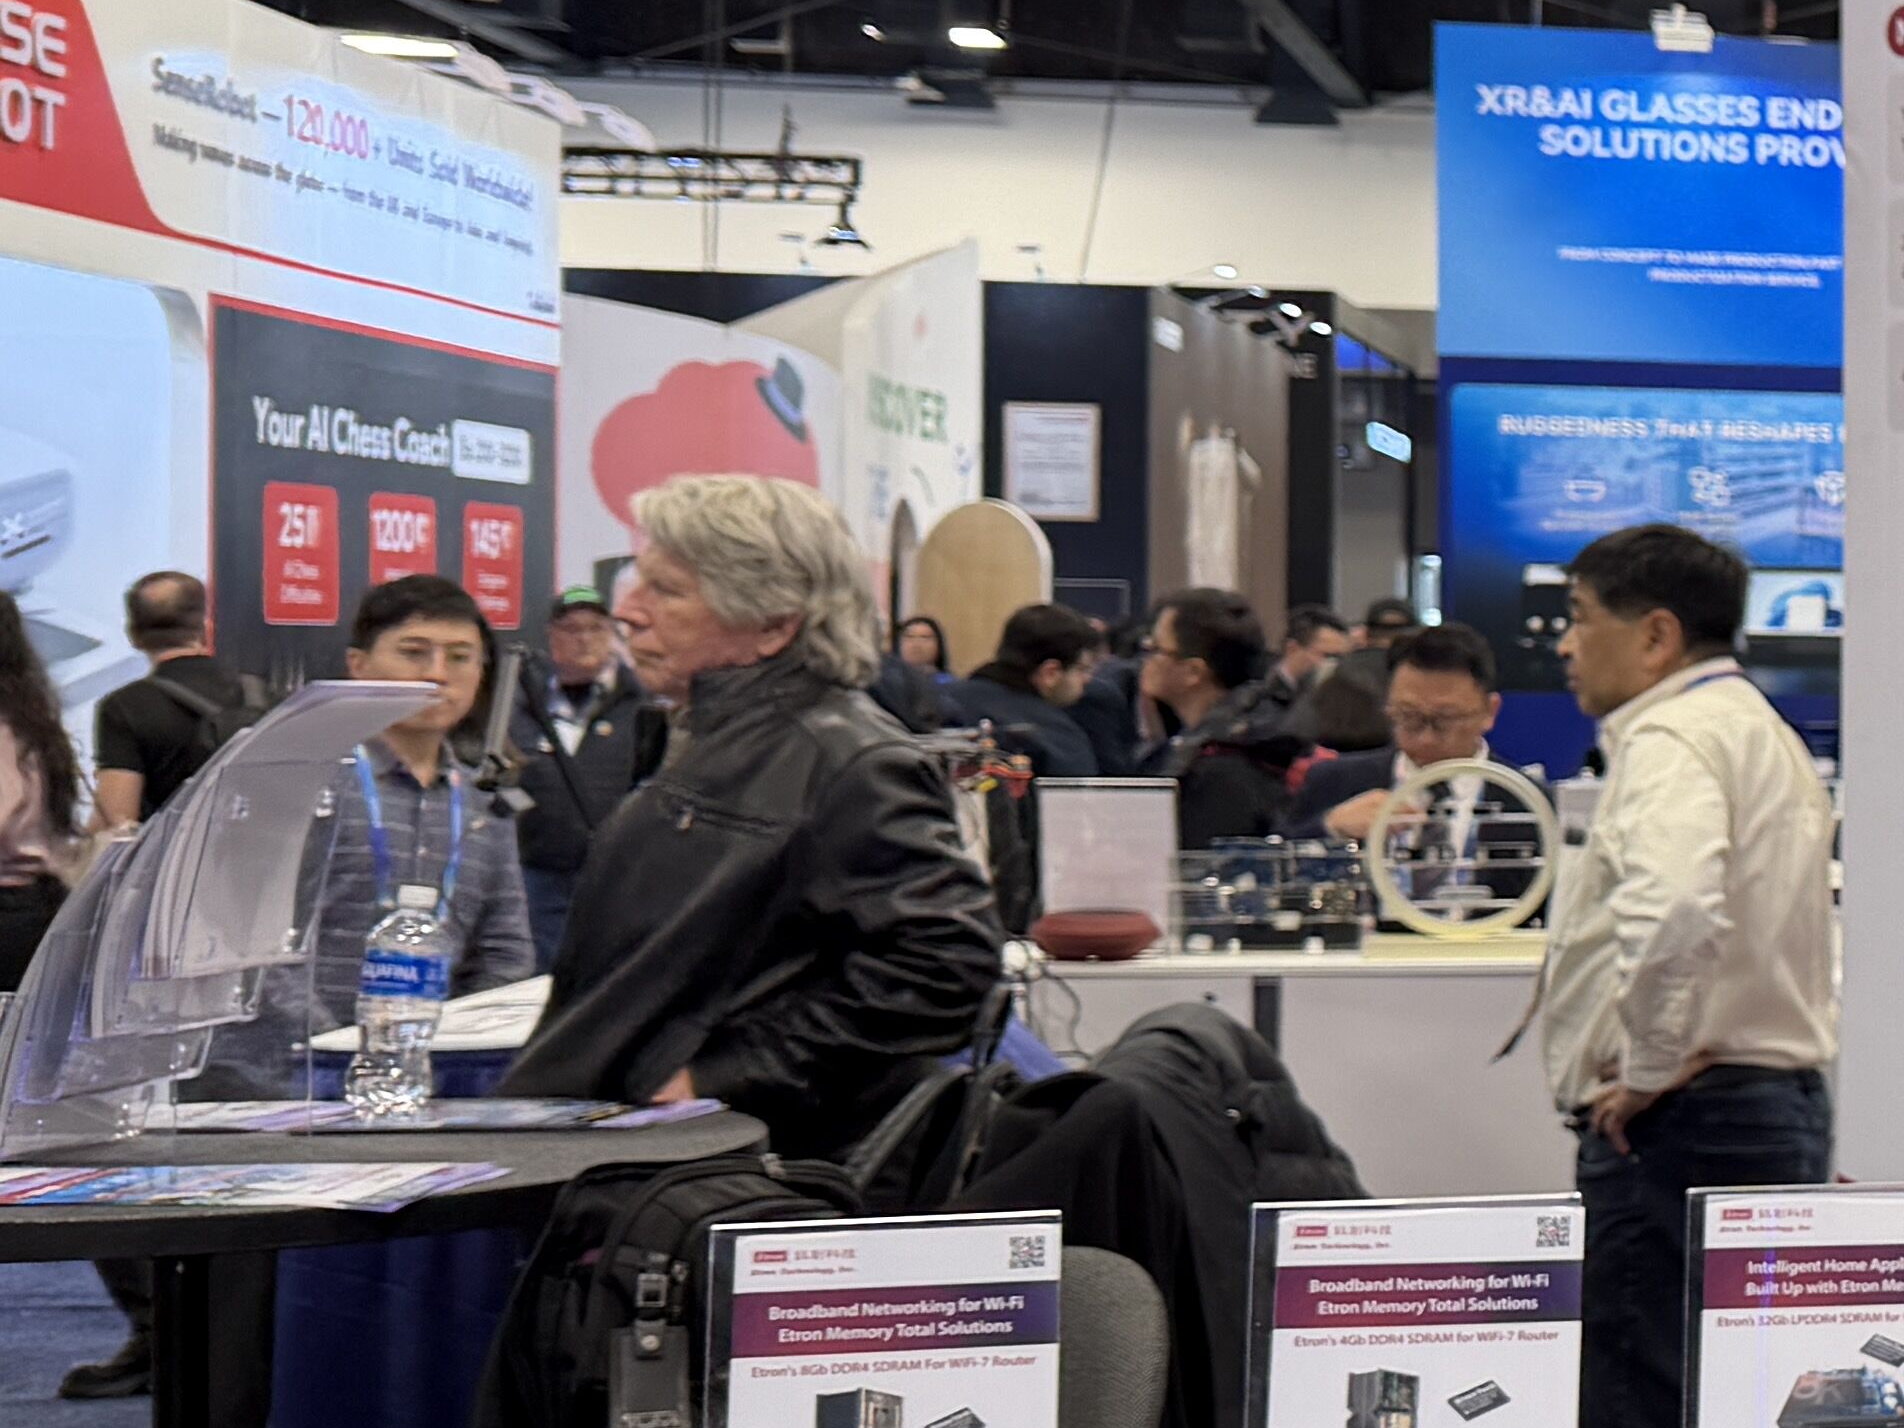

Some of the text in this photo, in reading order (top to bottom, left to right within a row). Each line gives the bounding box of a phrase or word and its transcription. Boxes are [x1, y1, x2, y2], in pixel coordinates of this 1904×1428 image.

[1475, 81, 1593, 121] XR&AI
[1600, 89, 1761, 129] GLASSES
[1538, 124, 1749, 165] SOLUTIONS
[251, 394, 306, 449] Your
[307, 403, 330, 453] AI
[333, 407, 392, 461] Chess
[393, 416, 451, 468] Coach
[1747, 1257, 1822, 1278] Intelligent
[1823, 1256, 1867, 1273] Home
[1308, 1274, 1510, 1295] Broadband Networking for
[1781, 1279, 1804, 1298] Up
[1805, 1278, 1839, 1295] with
[1840, 1277, 1879, 1294] Etron
[768, 1296, 984, 1322] Broadband Networking for
[1317, 1294, 1539, 1317] Etron Memory Total Solutions
[778, 1318, 1013, 1345] Etron Memory Total Solutions
